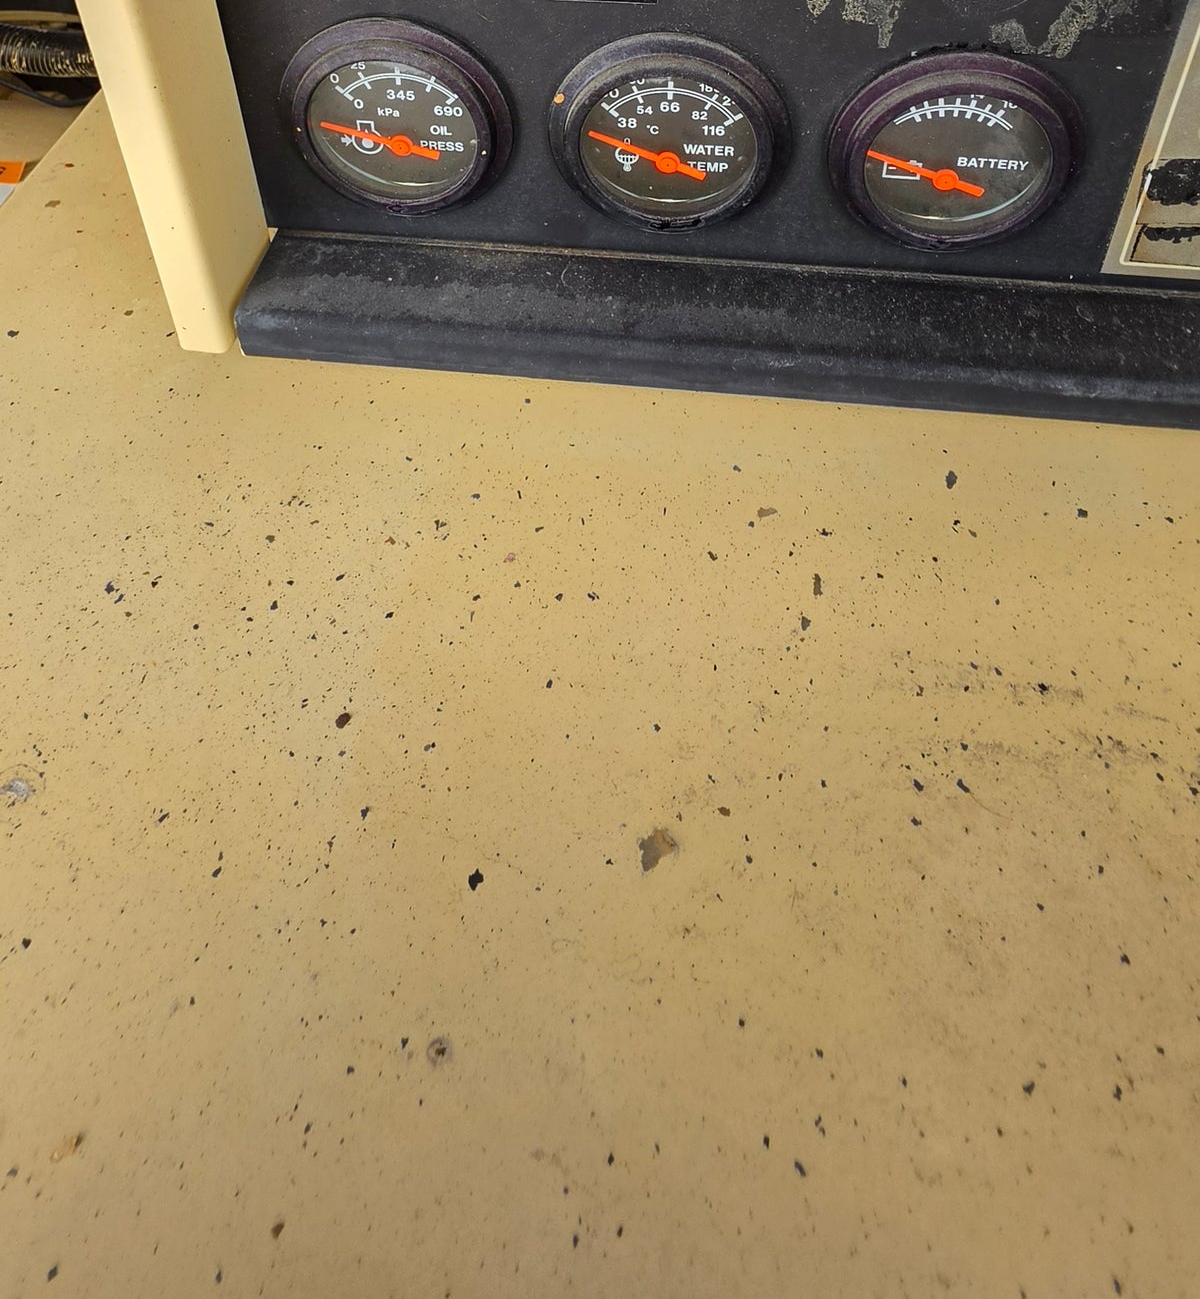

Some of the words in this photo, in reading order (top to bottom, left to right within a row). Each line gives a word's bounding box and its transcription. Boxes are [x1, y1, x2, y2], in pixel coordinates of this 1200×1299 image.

[329, 72, 340, 84] 0
[354, 99, 364, 109] 0
[386, 89, 415, 101] 345
[434, 105, 463, 117] 690
[377, 107, 400, 118] kPa
[617, 117, 637, 129] 38
[636, 105, 653, 115] 54
[660, 102, 680, 113] 66
[691, 111, 708, 120] 82
[702, 125, 725, 136] 116
[429, 125, 453, 136] OIL
[420, 140, 464, 152] PRESS
[683, 143, 735, 157] WATER
[687, 161, 729, 173] TEMP
[957, 156, 1029, 171] BATTERY
